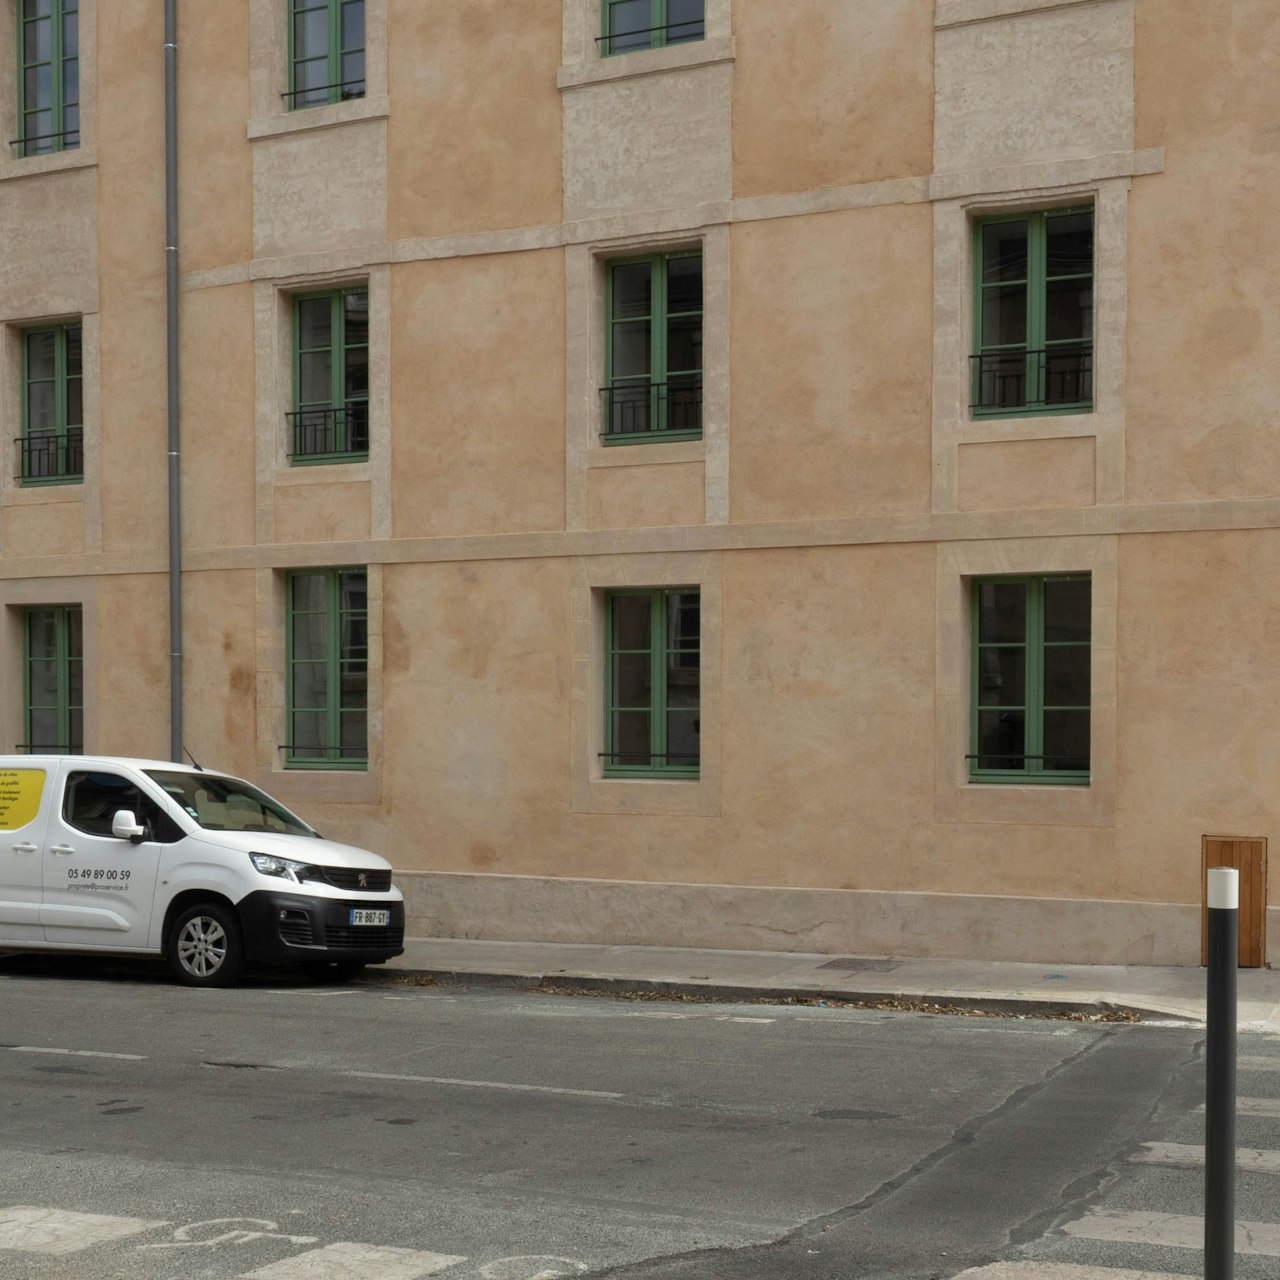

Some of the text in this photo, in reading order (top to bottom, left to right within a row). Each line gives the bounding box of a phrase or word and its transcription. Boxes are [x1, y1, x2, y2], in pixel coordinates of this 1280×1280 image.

[68, 869, 130, 880] 05 49 89 00 59
